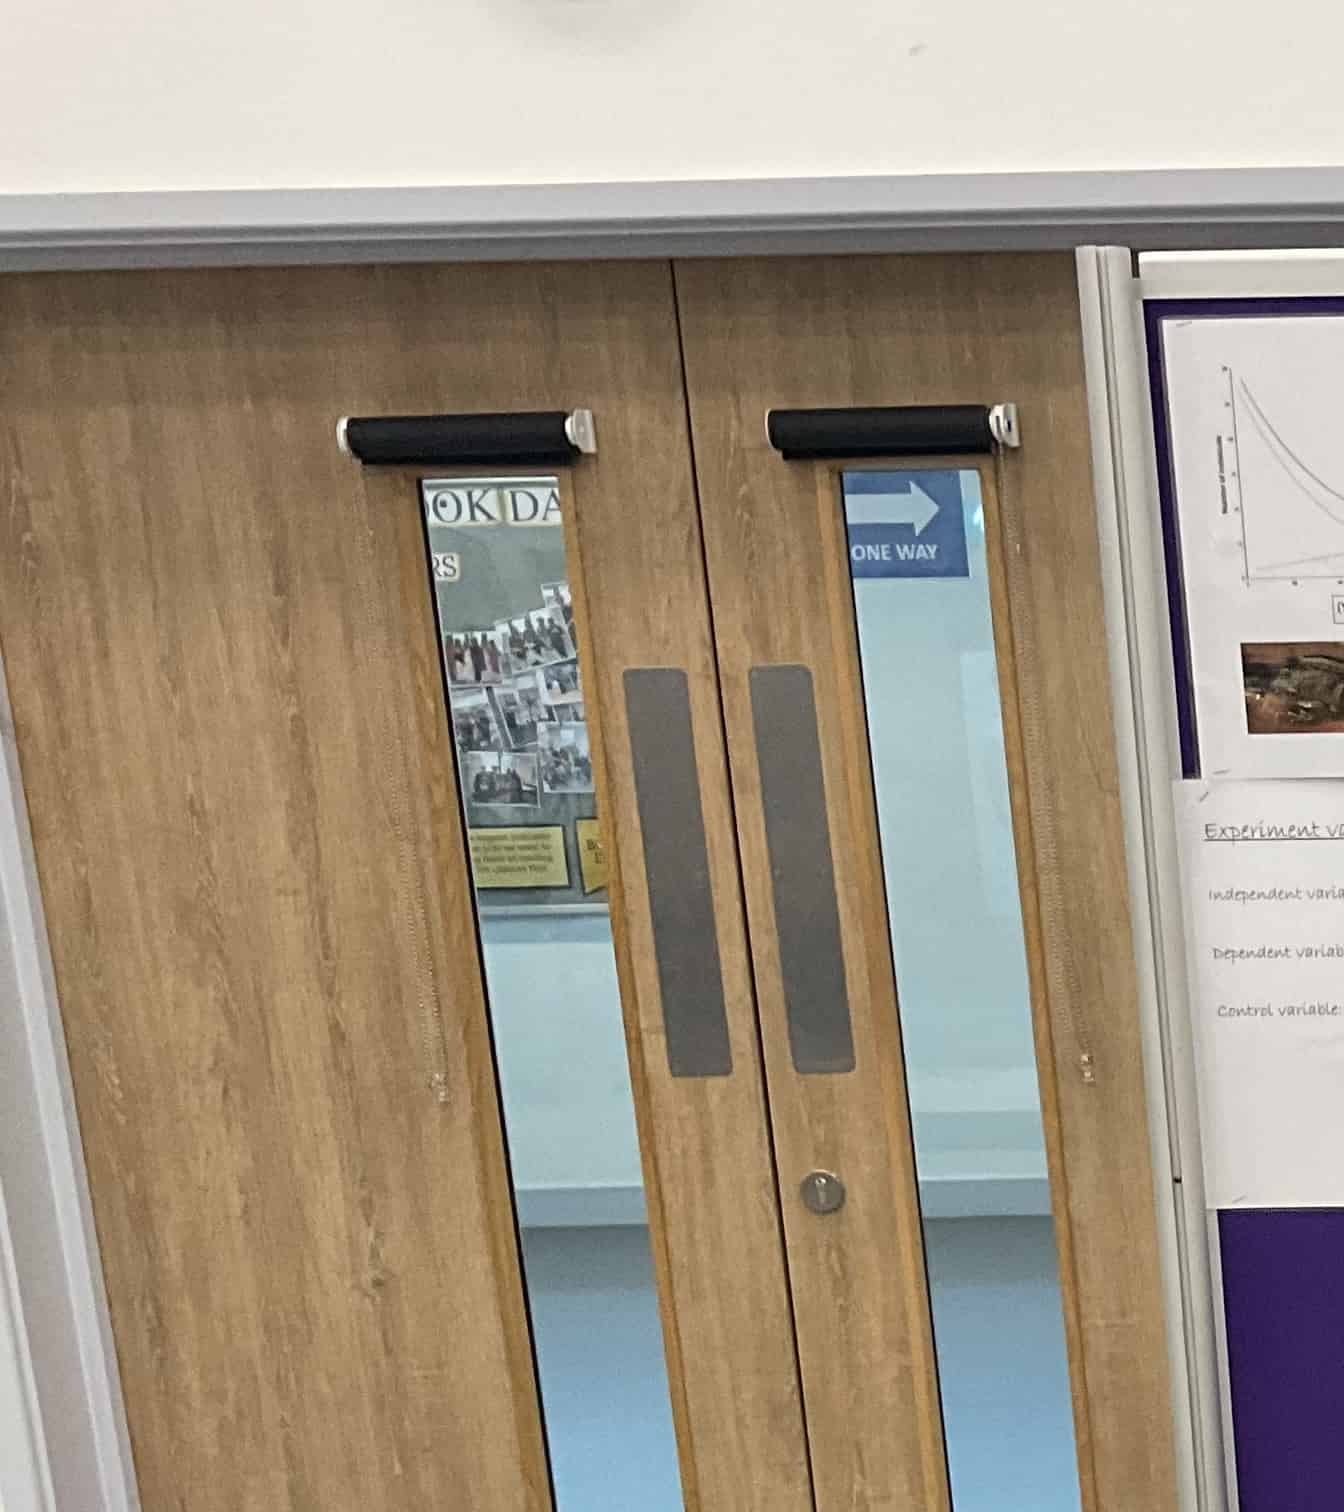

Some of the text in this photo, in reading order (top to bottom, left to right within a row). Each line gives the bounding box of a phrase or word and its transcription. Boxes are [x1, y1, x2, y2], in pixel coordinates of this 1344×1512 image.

[426, 488, 496, 523] OK
[851, 543, 938, 562] ONE WAY
[1204, 819, 1321, 846] Experiment
[1208, 887, 1302, 903] Independent
[1212, 946, 1291, 963] Dependent
[1217, 1003, 1274, 1017] Control
